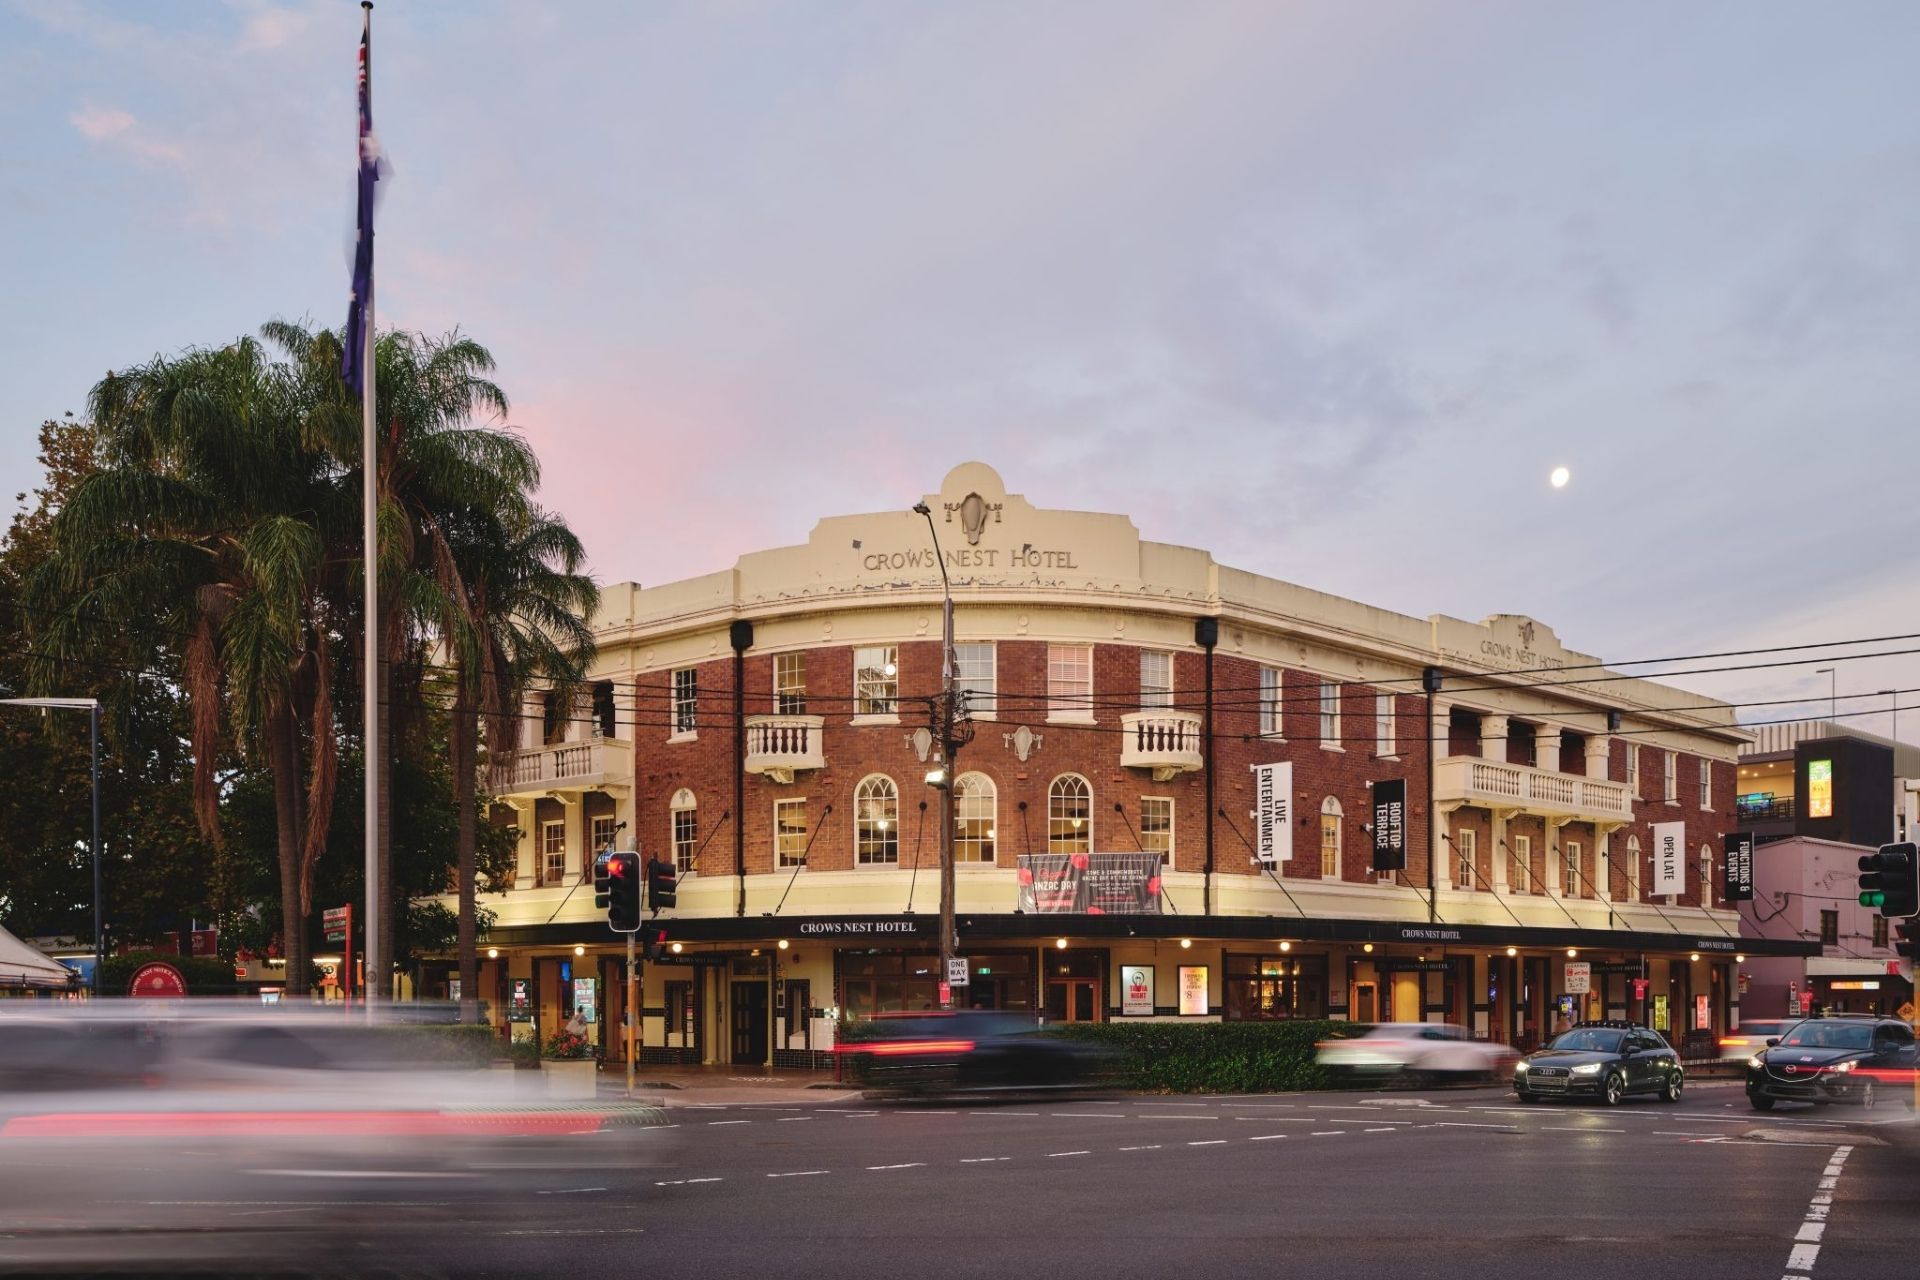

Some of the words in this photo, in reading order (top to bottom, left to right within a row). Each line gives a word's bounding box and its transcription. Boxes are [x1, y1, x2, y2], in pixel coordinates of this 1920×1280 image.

[946, 550, 999, 567] NEST
[1011, 550, 1078, 568] HOTEL
[1480, 640, 1511, 660] CROWS
[1515, 648, 1536, 666] NEST
[1261, 768, 1273, 858] ENTERTAINMENT
[1275, 799, 1286, 824] LIVE
[1376, 803, 1388, 849] TERRACE
[1390, 802, 1402, 848] ROOFTOP
[1663, 836, 1674, 858] OPEN
[1664, 861, 1674, 880] LATE
[1728, 852, 1738, 882] EVENTS
[1739, 841, 1750, 884] FUNCTIONS
[1032, 881, 1059, 891] ANZAC
[1061, 881, 1077, 891] DAY
[800, 923, 841, 933] CROWS
[844, 922, 873, 932] NEST
[876, 922, 916, 932] HOTEL
[1401, 929, 1424, 938] CROWS
[1425, 930, 1440, 939] NEST
[1441, 930, 1461, 939] HOTEL
